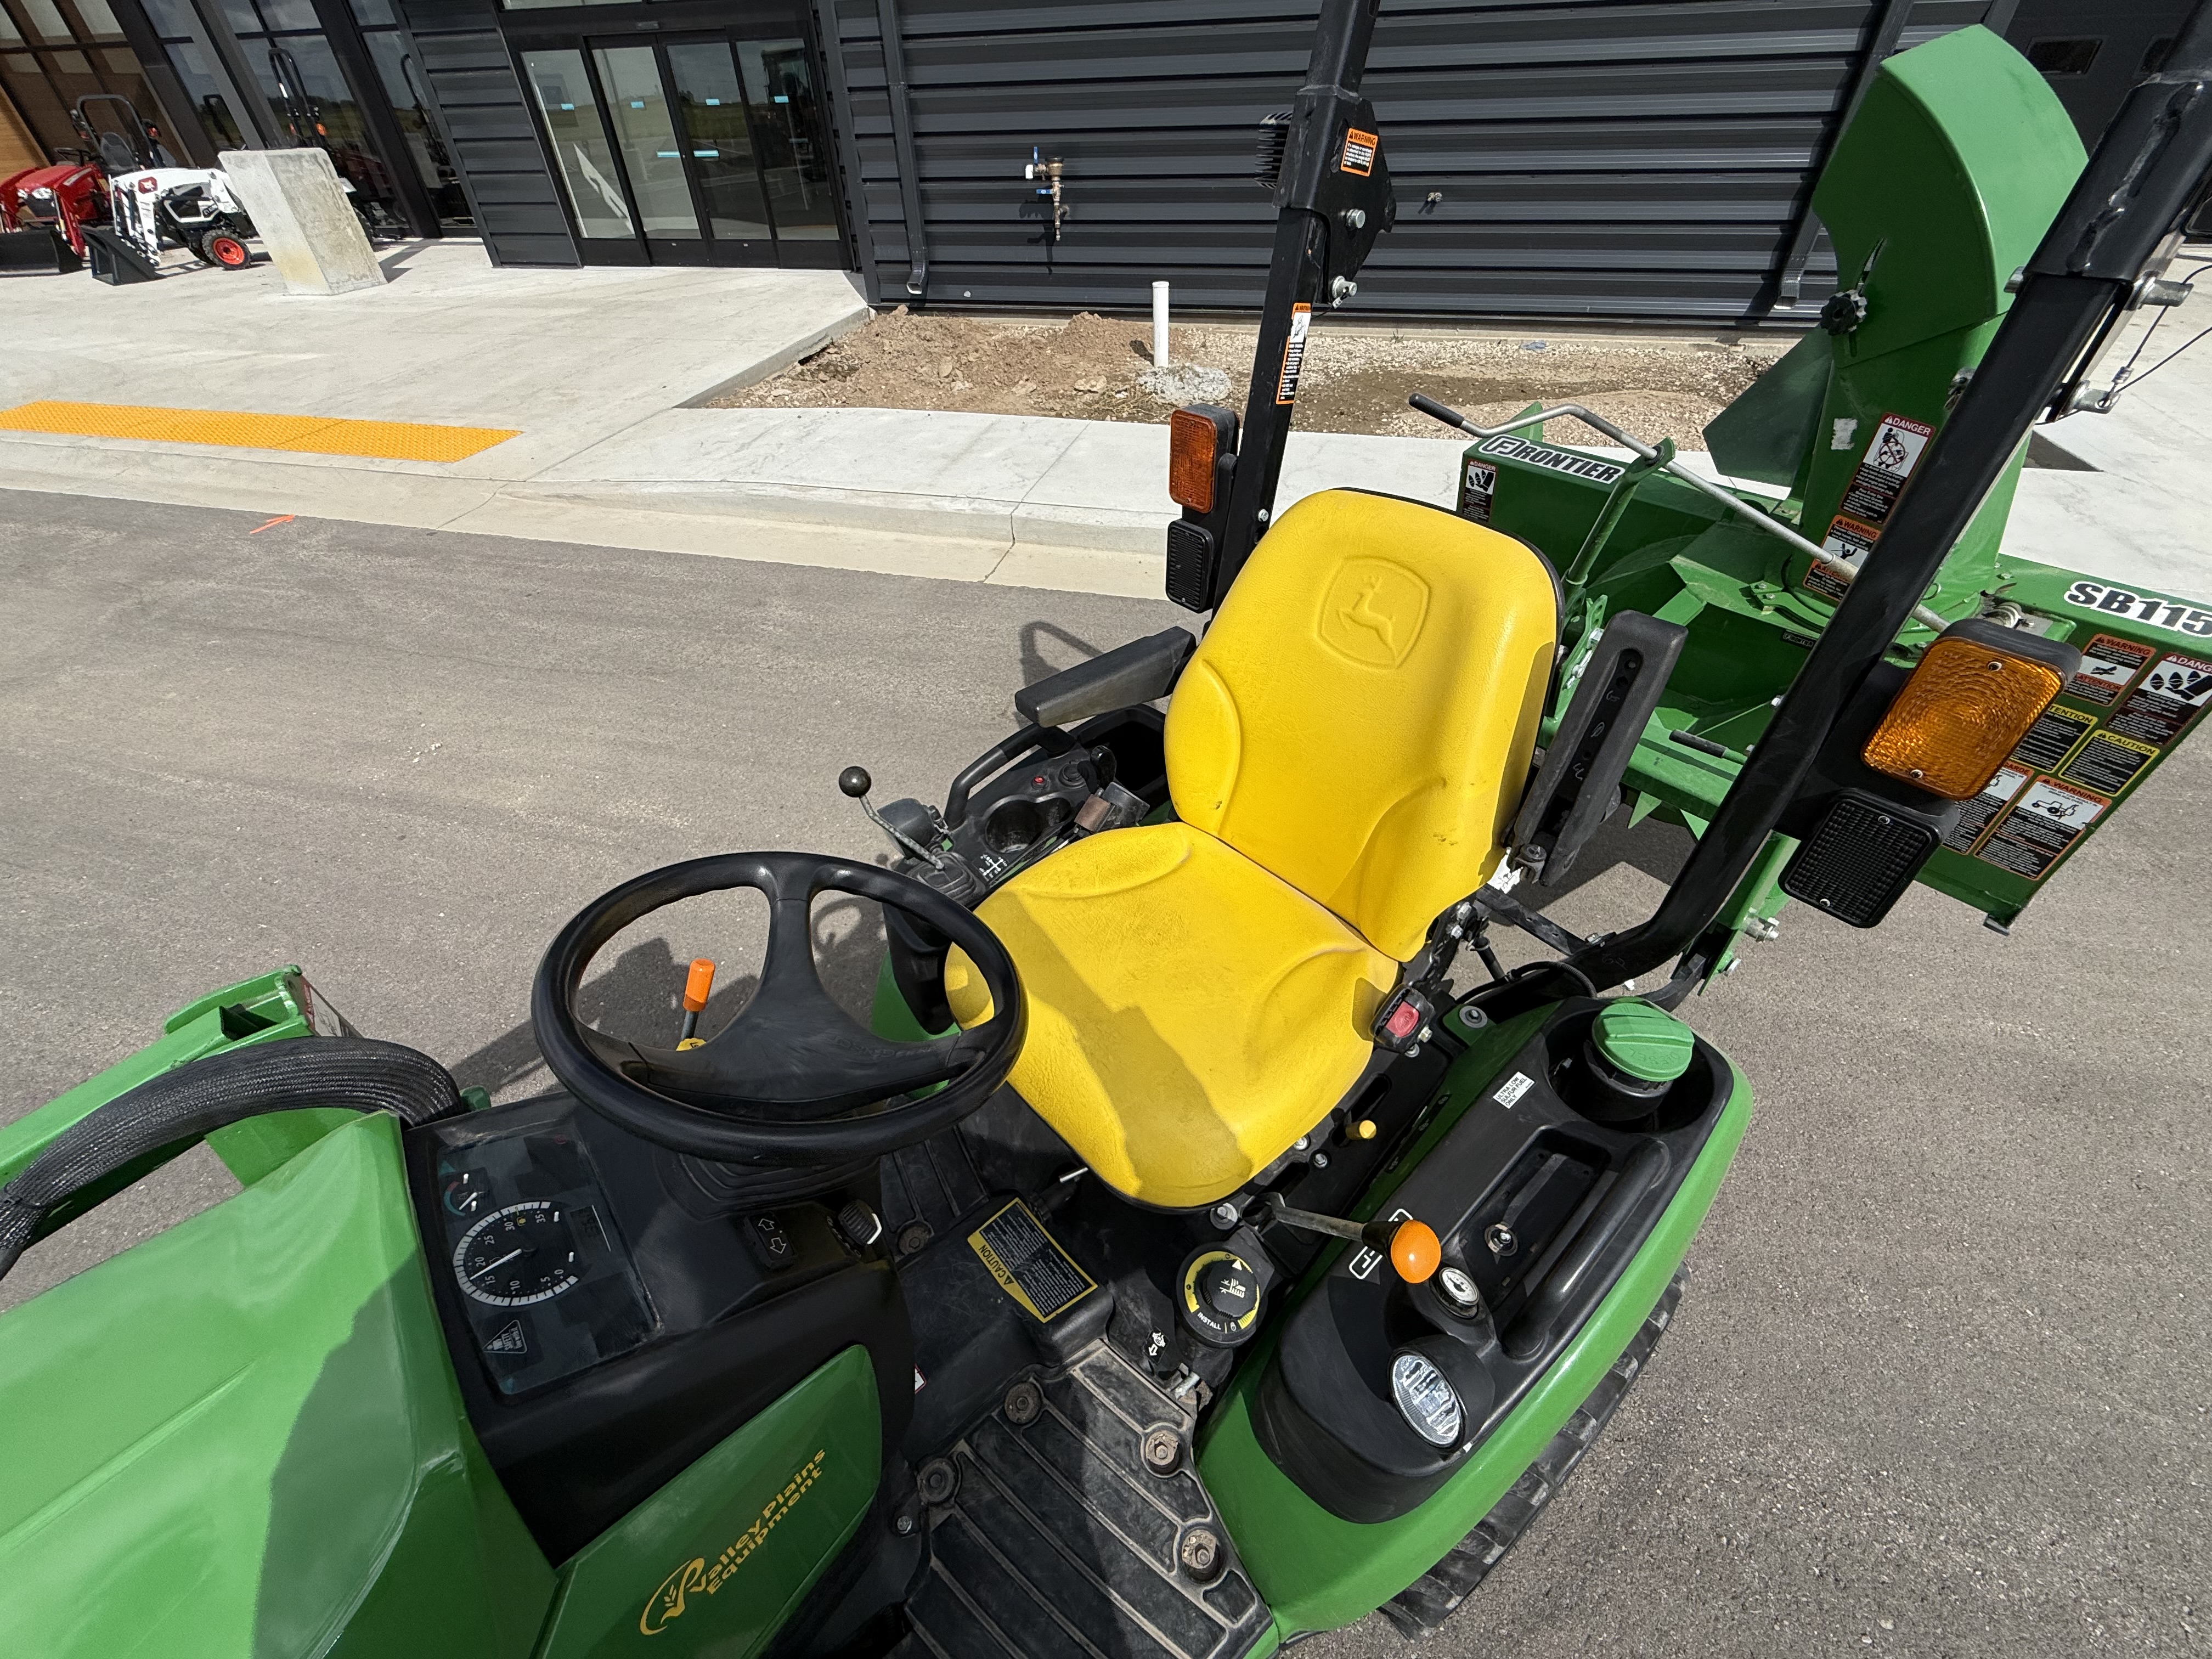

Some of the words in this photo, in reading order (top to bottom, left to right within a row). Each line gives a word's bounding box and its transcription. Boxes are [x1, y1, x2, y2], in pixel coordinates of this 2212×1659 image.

[1354, 132, 1376, 145] WARNING
[1892, 417, 1931, 436] DANGER
[1474, 461, 1496, 471] DANGER
[1481, 436, 1621, 482] FRONTIER
[1844, 520, 1877, 538] WARNING
[2067, 583, 2212, 636] SB115
[2106, 639, 2151, 656] WARNING
[2177, 657, 2212, 673] DANG
[2049, 706, 2094, 723] TENTION
[2108, 734, 2156, 755] CAUTION
[2055, 782, 2102, 803] WARNING
[1630, 1048, 1681, 1065] DIESEL
[1497, 1086, 1510, 1100] ULTRA
[1510, 1077, 1519, 1086] LOW
[1501, 1087, 1516, 1103] SULFUR
[1516, 1077, 1526, 1088] FUEL
[1505, 1094, 1516, 1106] ONLY
[504, 1221, 515, 1231] 30
[535, 1214, 546, 1223] 35
[483, 1235, 495, 1245] 25
[475, 1257, 486, 1267] 20
[978, 1244, 1006, 1278] CAUTION
[485, 1276, 495, 1284] 15
[510, 1280, 521, 1290] 10
[1198, 1312, 1221, 1330] INSTALL
[501, 1333, 513, 1350] SAFETY
[689, 1518, 761, 1593] Valley
[762, 1449, 826, 1519] Plains
[707, 1466, 822, 1595] Equipment
